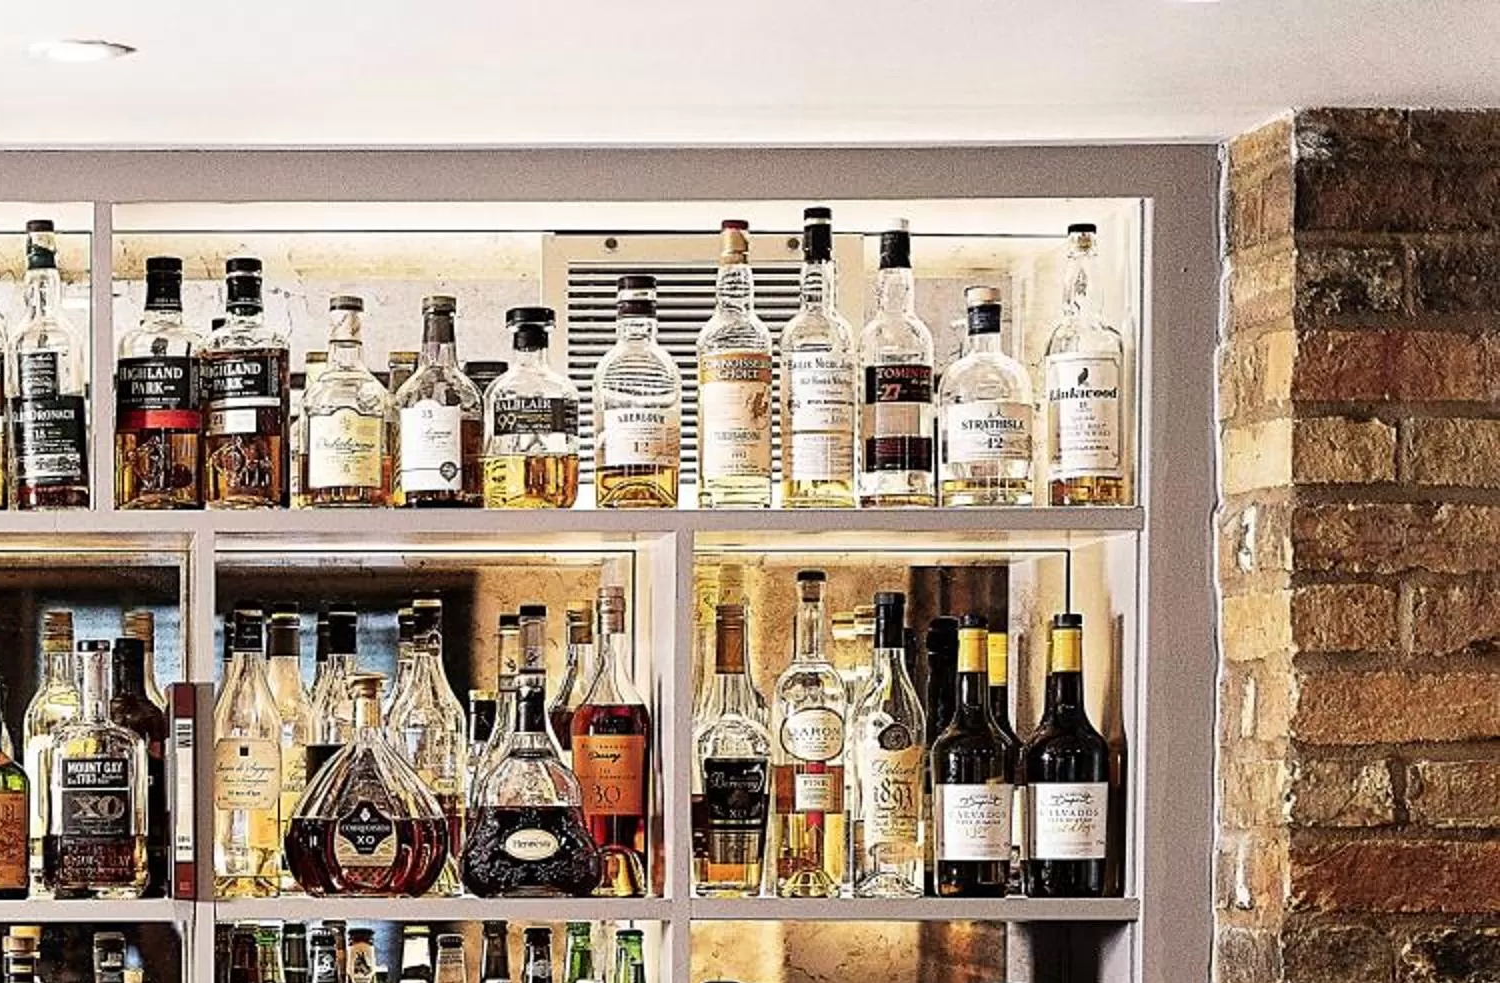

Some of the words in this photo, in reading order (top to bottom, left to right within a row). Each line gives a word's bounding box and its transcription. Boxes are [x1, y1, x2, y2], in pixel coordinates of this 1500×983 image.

[66, 761, 103, 774] MOUNT
[71, 795, 126, 821] XO
[355, 835, 376, 845] XO
